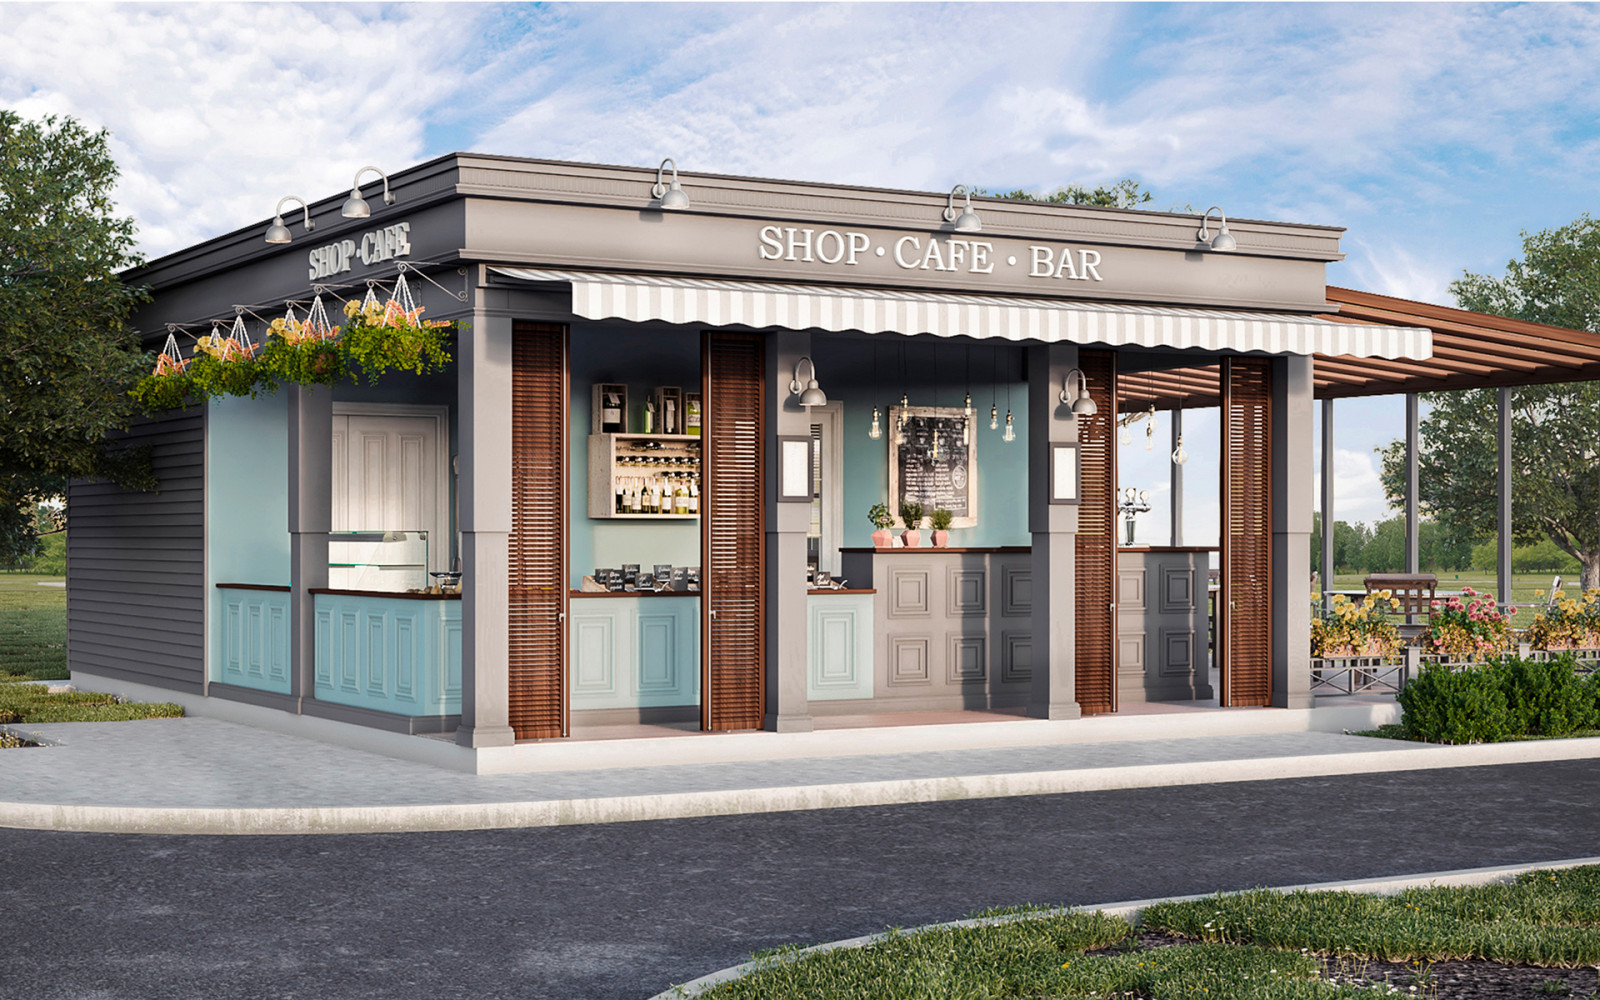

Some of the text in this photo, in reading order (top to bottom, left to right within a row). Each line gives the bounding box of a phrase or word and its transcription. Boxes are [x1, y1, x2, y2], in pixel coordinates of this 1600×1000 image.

[309, 222, 411, 281] SHOP CAFE
[758, 225, 1104, 282] SHOP CAFE BAR
